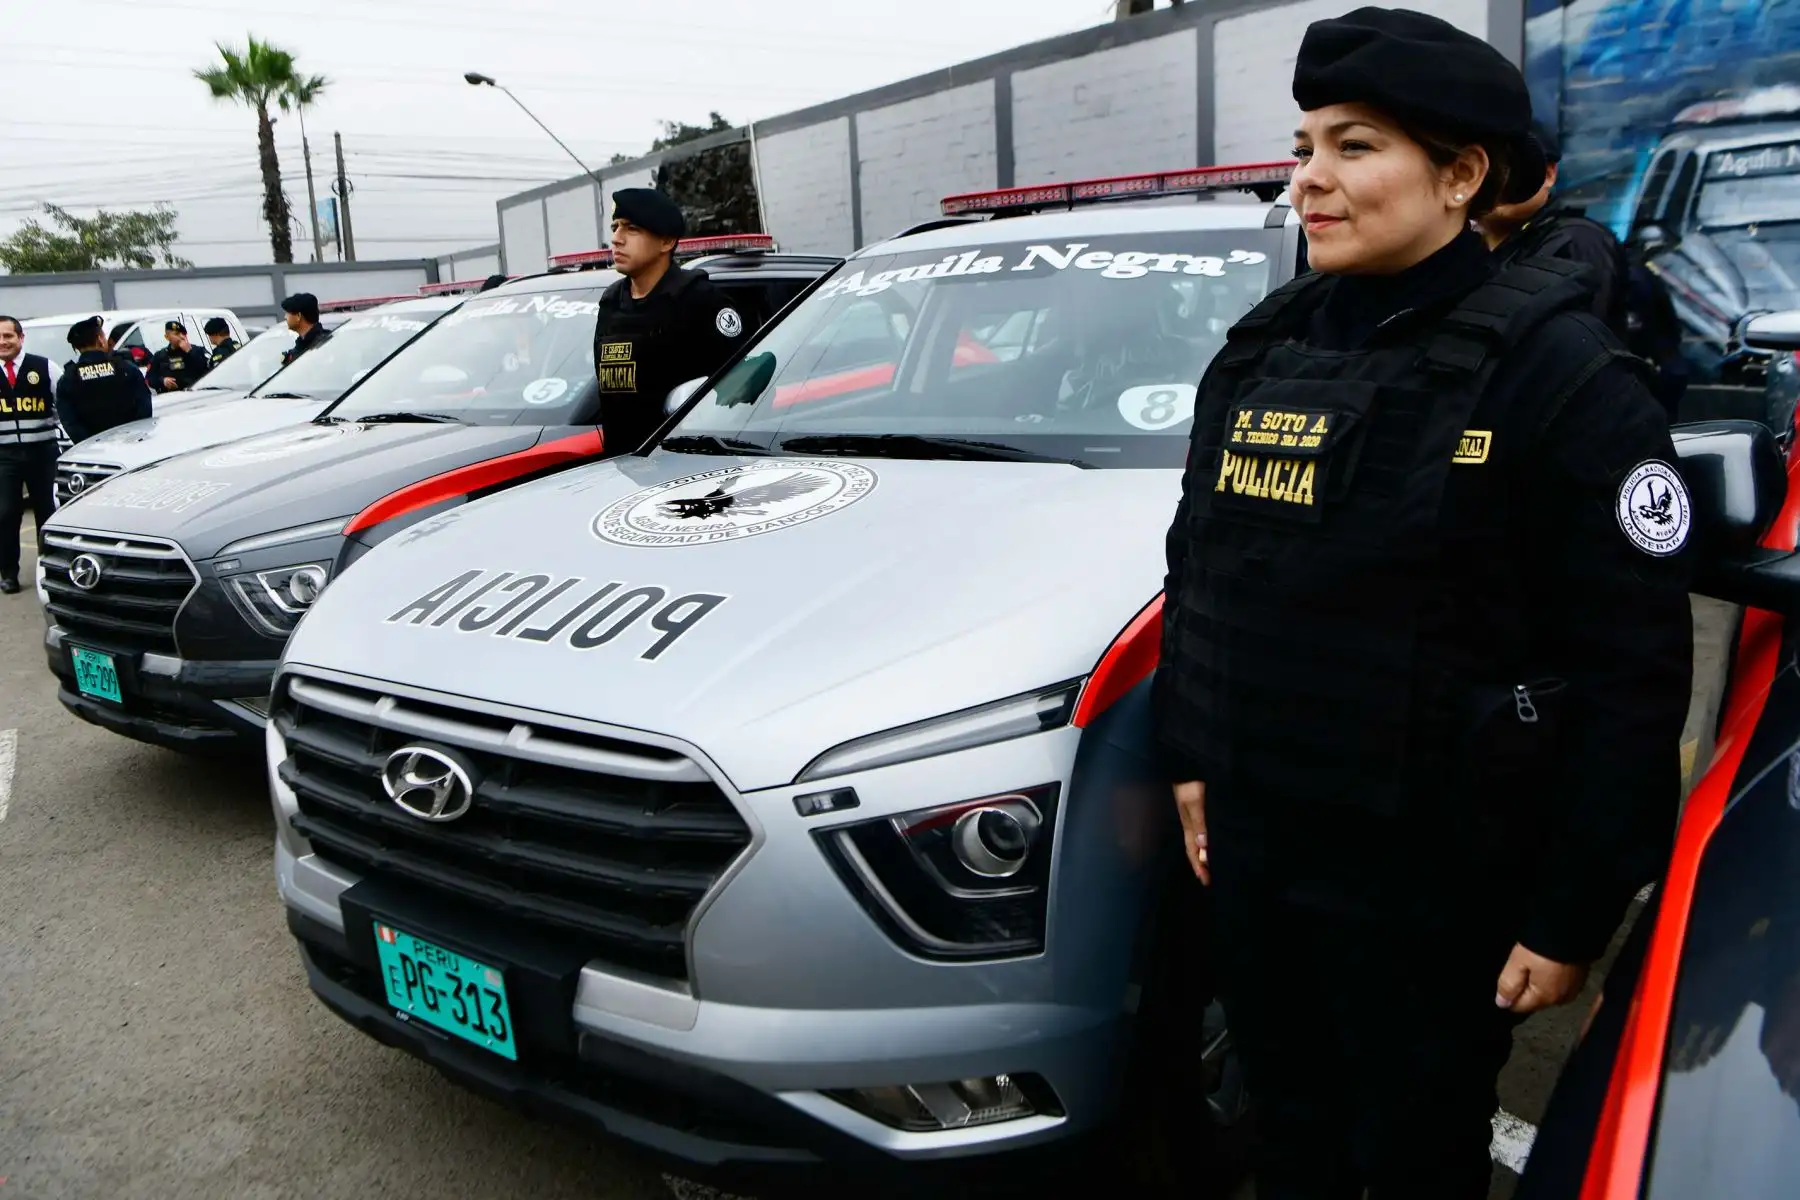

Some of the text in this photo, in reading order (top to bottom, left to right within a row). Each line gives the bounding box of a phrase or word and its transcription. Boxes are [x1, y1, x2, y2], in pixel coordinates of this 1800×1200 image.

[601, 366, 634, 389] POLICIA
[1140, 390, 1178, 425] 8
[1235, 410, 1328, 434] M. SOTO A.
[1214, 449, 1317, 505] POLICIA
[1623, 472, 1642, 500] POLICIA
[608, 526, 703, 544] SEGURIDAD
[708, 529, 739, 541] DE
[746, 504, 836, 534] BANCOS
[668, 521, 737, 532] NEGRA
[1623, 515, 1680, 550] UNISEBAN
[412, 939, 460, 973] PERU
